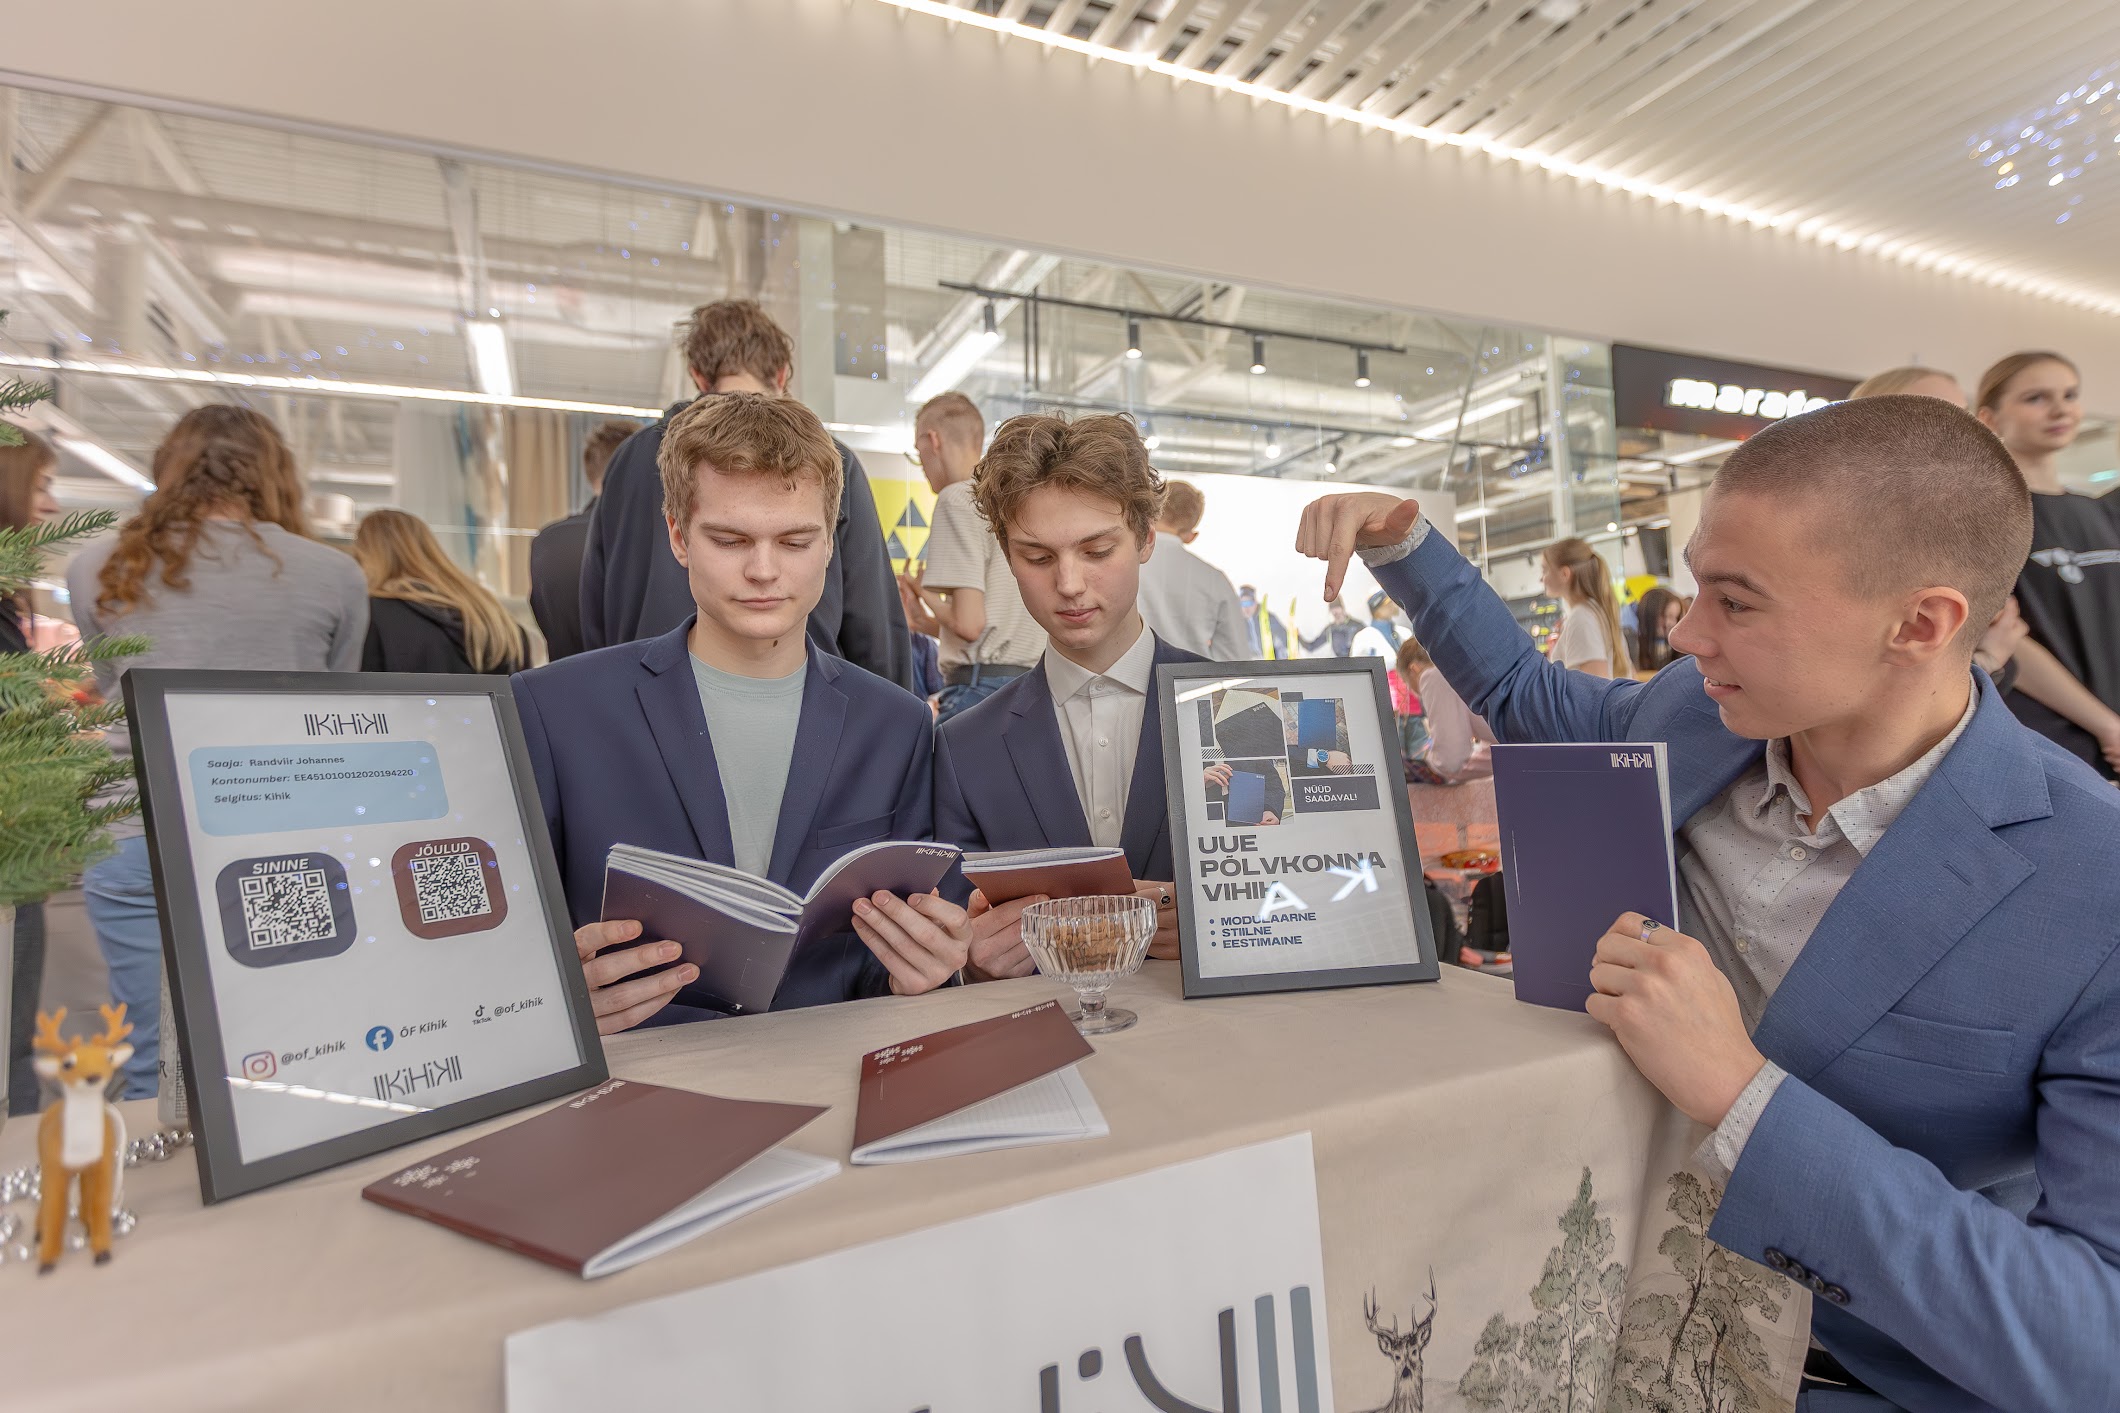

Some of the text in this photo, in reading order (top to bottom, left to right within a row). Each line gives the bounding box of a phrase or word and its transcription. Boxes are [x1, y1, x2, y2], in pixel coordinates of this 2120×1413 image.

[207, 756, 345, 769] Saaja: Randviir Johannes
[211, 769, 415, 786] Kontonumber: EE451010012020194220
[214, 791, 291, 804] Selgitus: Kihik
[1305, 793, 1358, 803] SAADAVAL!
[415, 842, 470, 858] JÕULUD
[1198, 834, 1259, 854] UUE
[252, 858, 309, 875] SININE
[1200, 851, 1387, 878] PÕLVKONNA
[1220, 912, 1317, 926] MODULAARNE
[1222, 926, 1272, 938] STIILNE
[1223, 935, 1303, 949] EESTIMAINE
[494, 997, 544, 1017] @of_kihik
[419, 1019, 448, 1034] Kihik
[281, 1040, 346, 1065] @of_kihik
